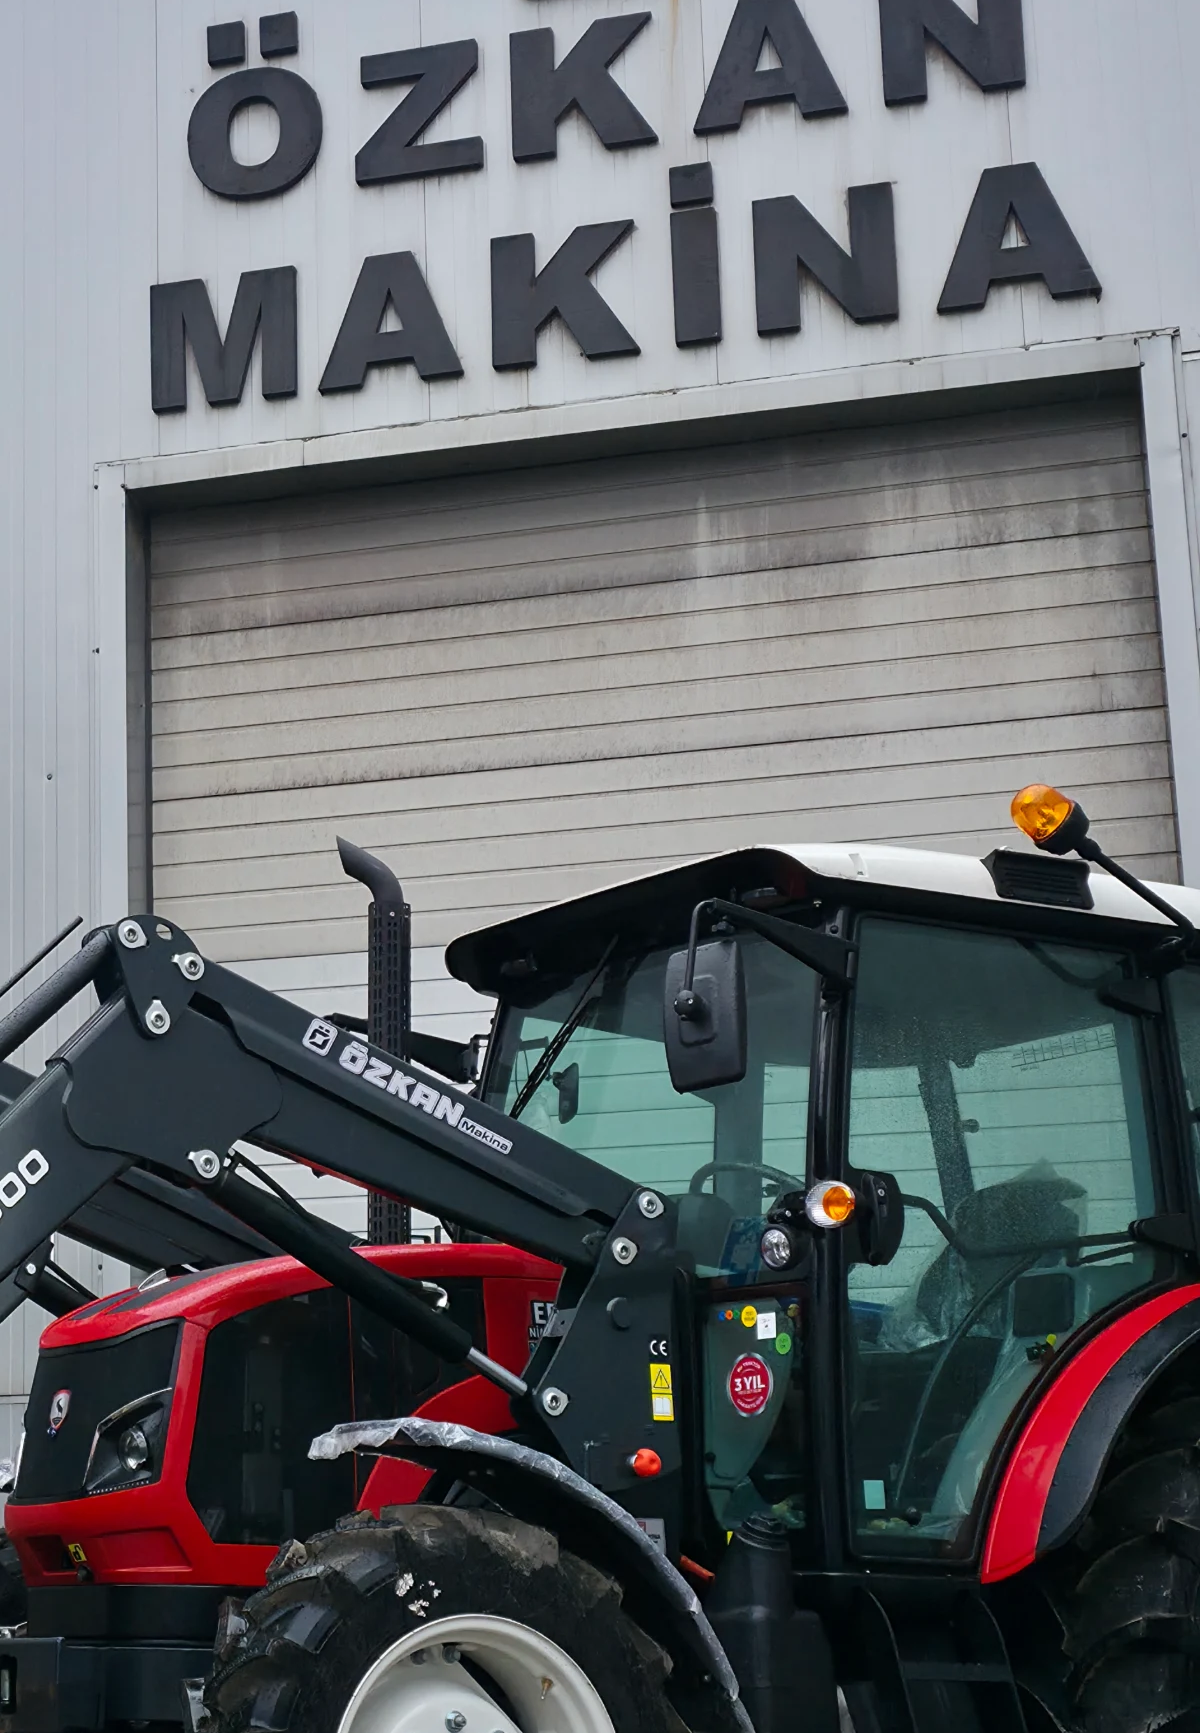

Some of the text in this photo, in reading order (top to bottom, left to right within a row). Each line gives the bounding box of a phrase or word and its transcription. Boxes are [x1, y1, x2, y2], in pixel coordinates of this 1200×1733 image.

[150, 162, 1102, 414] MAKİNA
[338, 1041, 509, 1153] ÖZKAN Makina
[649, 1339, 668, 1357] CE
[734, 1378, 743, 1393] 3
[743, 1374, 766, 1390] YIL
